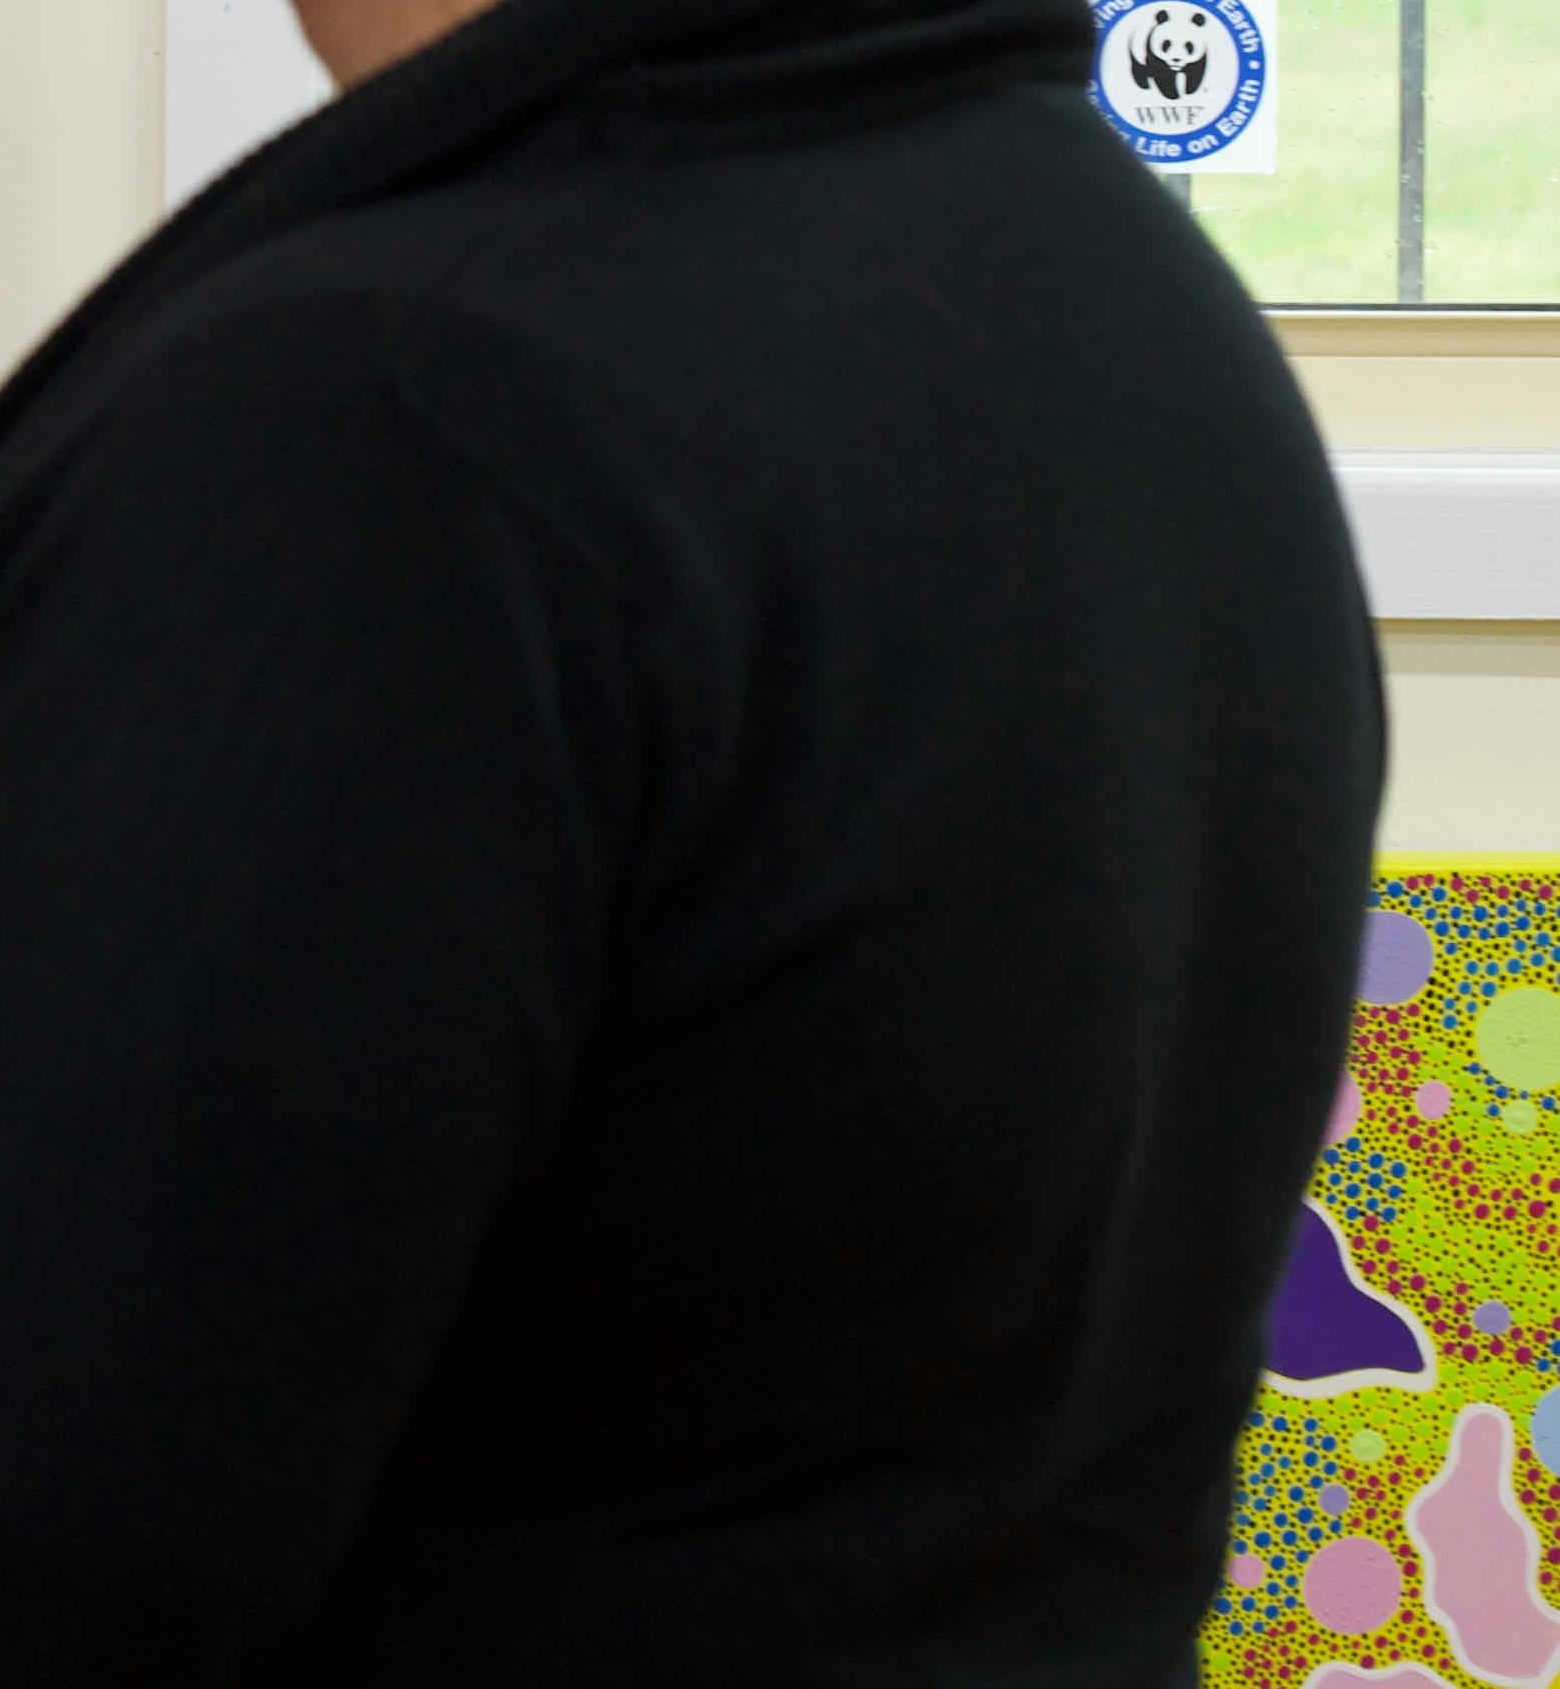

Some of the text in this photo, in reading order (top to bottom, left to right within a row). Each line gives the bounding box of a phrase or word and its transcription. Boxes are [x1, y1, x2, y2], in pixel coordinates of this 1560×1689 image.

[1134, 106, 1205, 125] WWF
[1135, 79, 1260, 157] Life on Earth
